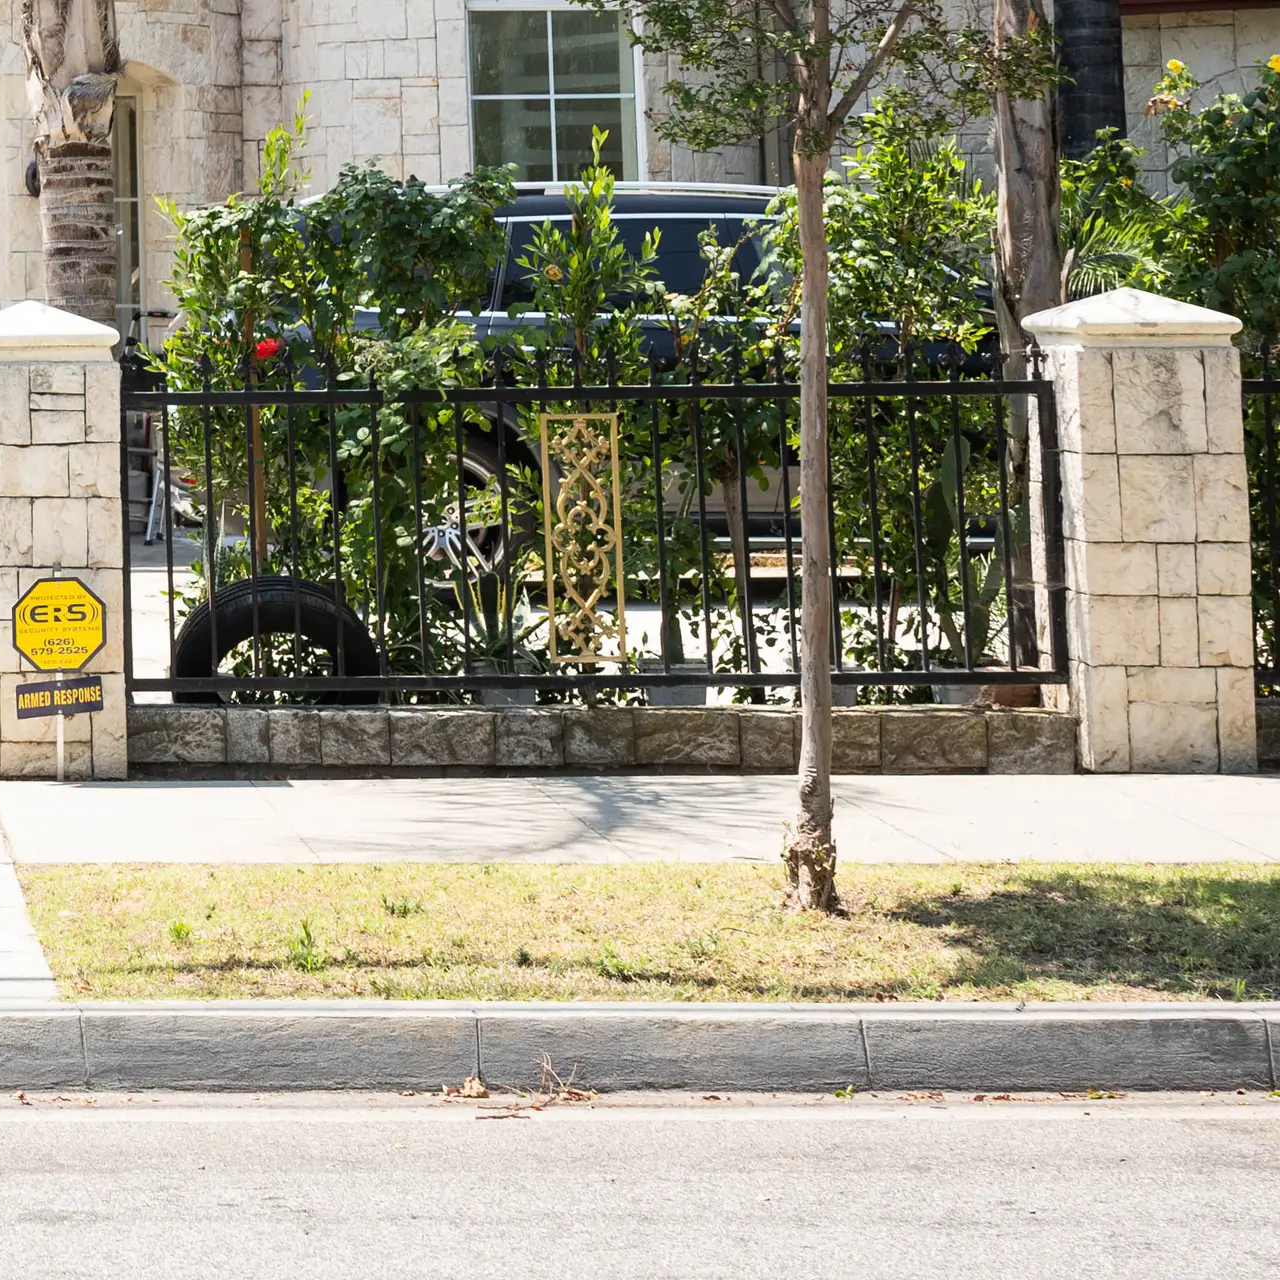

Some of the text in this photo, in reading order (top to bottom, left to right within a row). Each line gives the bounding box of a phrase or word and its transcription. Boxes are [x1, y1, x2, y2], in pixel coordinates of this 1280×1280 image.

[30, 604, 86, 622] ERS
[43, 638, 75, 646] (626)
[31, 647, 88, 656] 579-2525
[18, 686, 102, 709] ARMED RESPONSE
